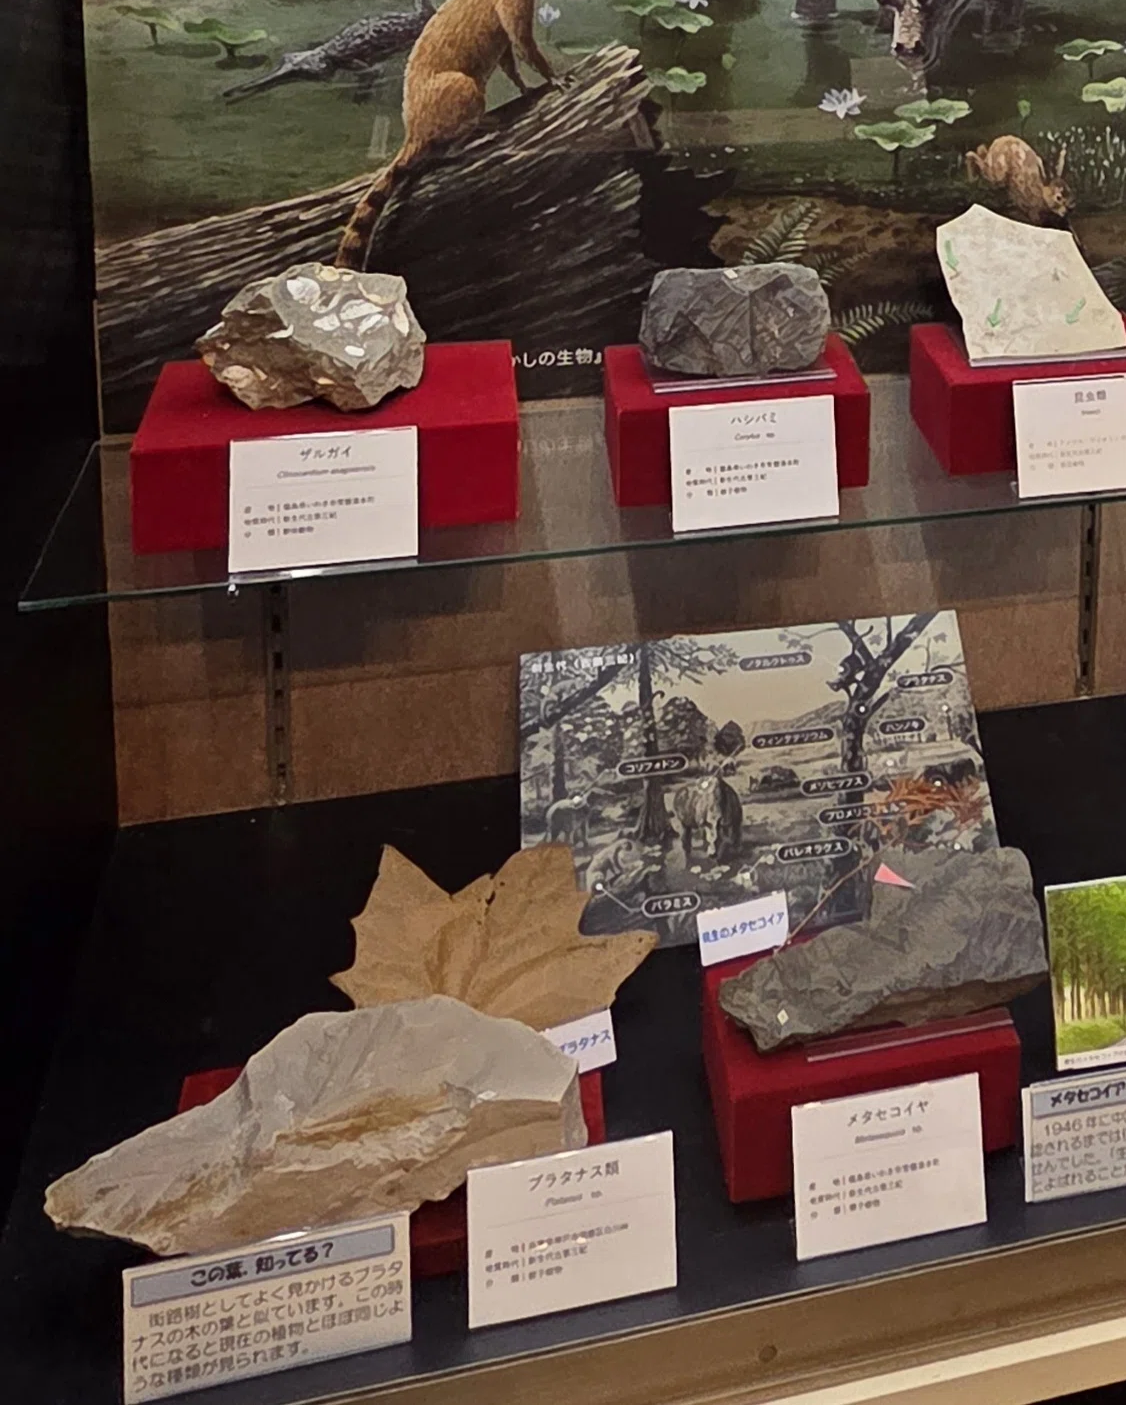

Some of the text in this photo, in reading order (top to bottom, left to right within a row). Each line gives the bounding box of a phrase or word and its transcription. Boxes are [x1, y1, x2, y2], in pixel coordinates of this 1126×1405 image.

[730, 411, 777, 425] ハシバミ
[299, 446, 352, 461] ザルガイ
[847, 1101, 929, 1127] メタセコイヤ
[528, 1160, 620, 1191] プラタナス類
[149, 1260, 404, 1327] 街路樹としてよく見かけるプラタ
[131, 1300, 405, 1372] 代になると現在の植物とほぼ同じよ
